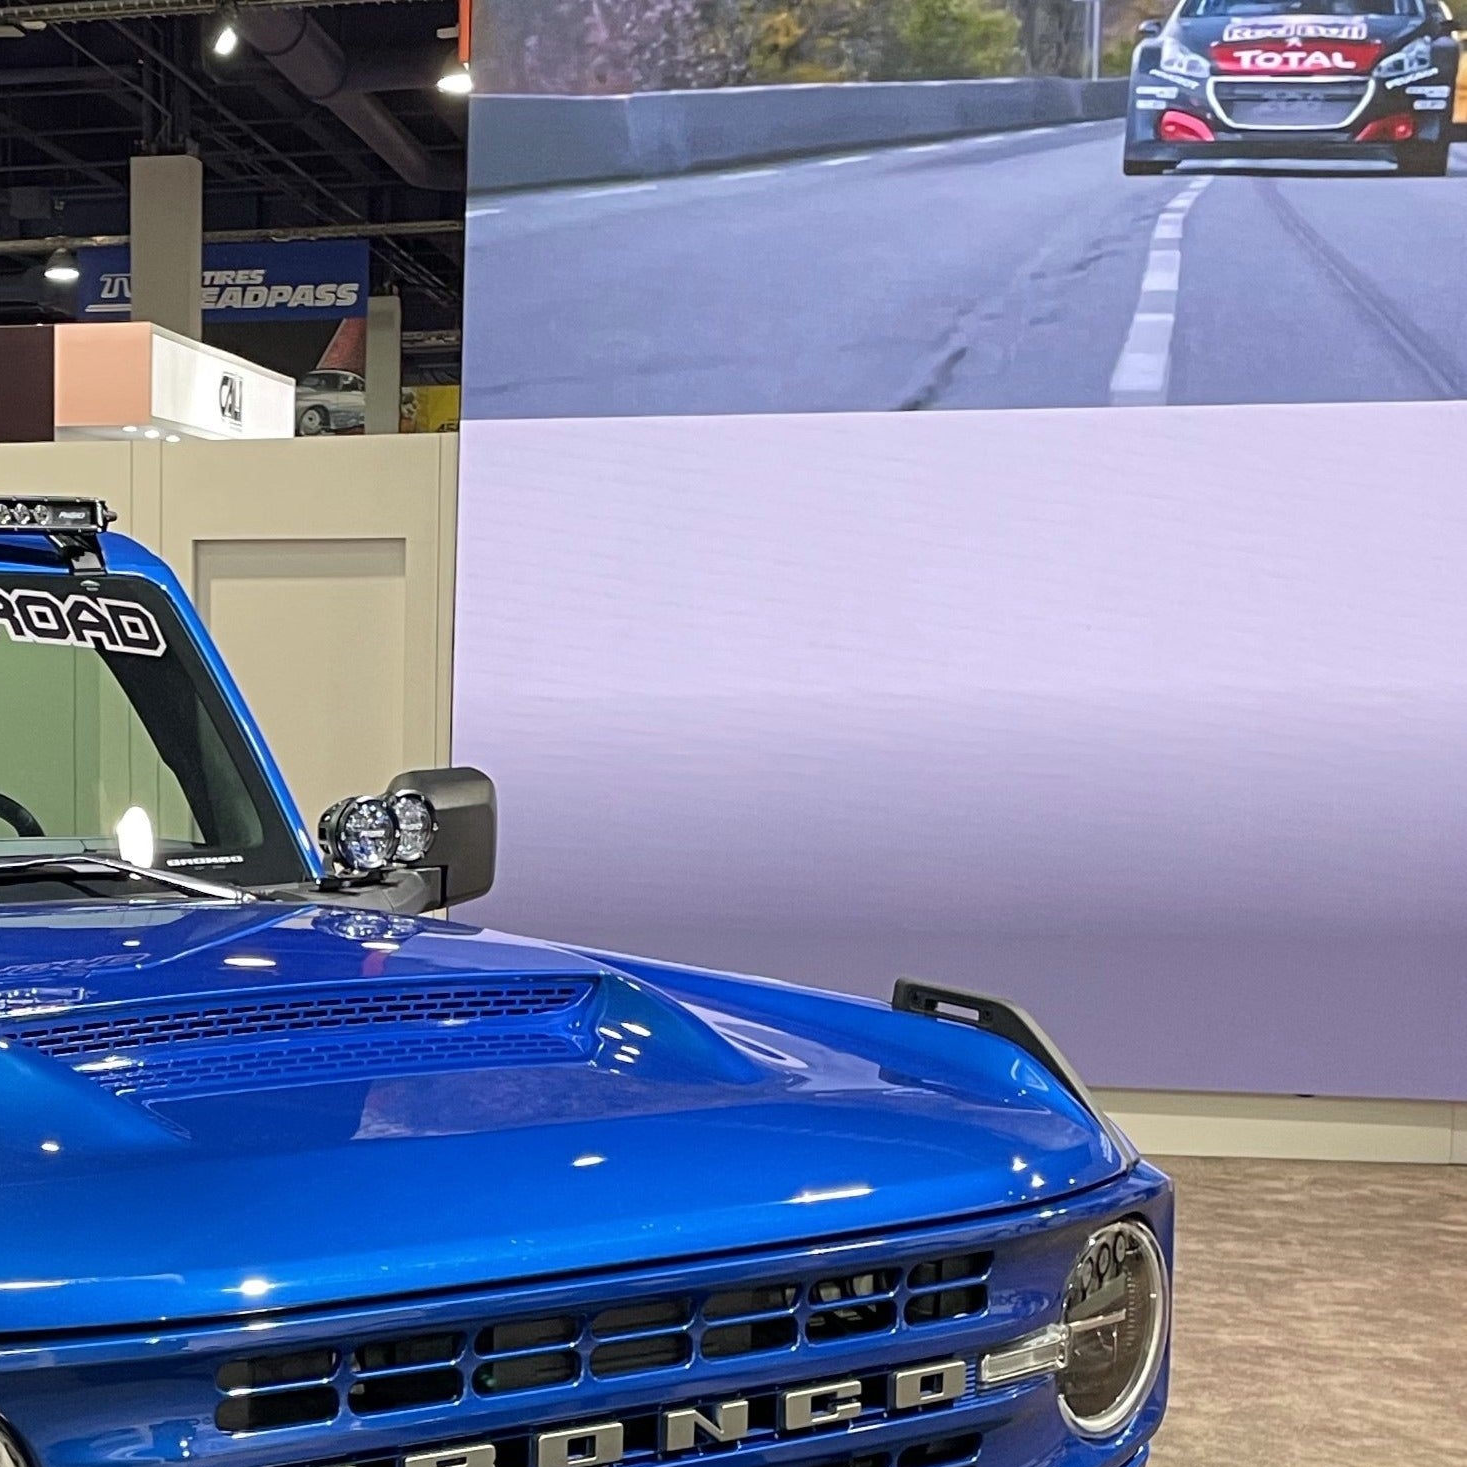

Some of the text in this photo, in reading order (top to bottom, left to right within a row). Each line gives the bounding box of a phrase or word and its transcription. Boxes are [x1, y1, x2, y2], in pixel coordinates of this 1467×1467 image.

[1233, 50, 1357, 69] TOTAL
[203, 270, 265, 284] TIRES
[202, 283, 359, 309] EADPASS
